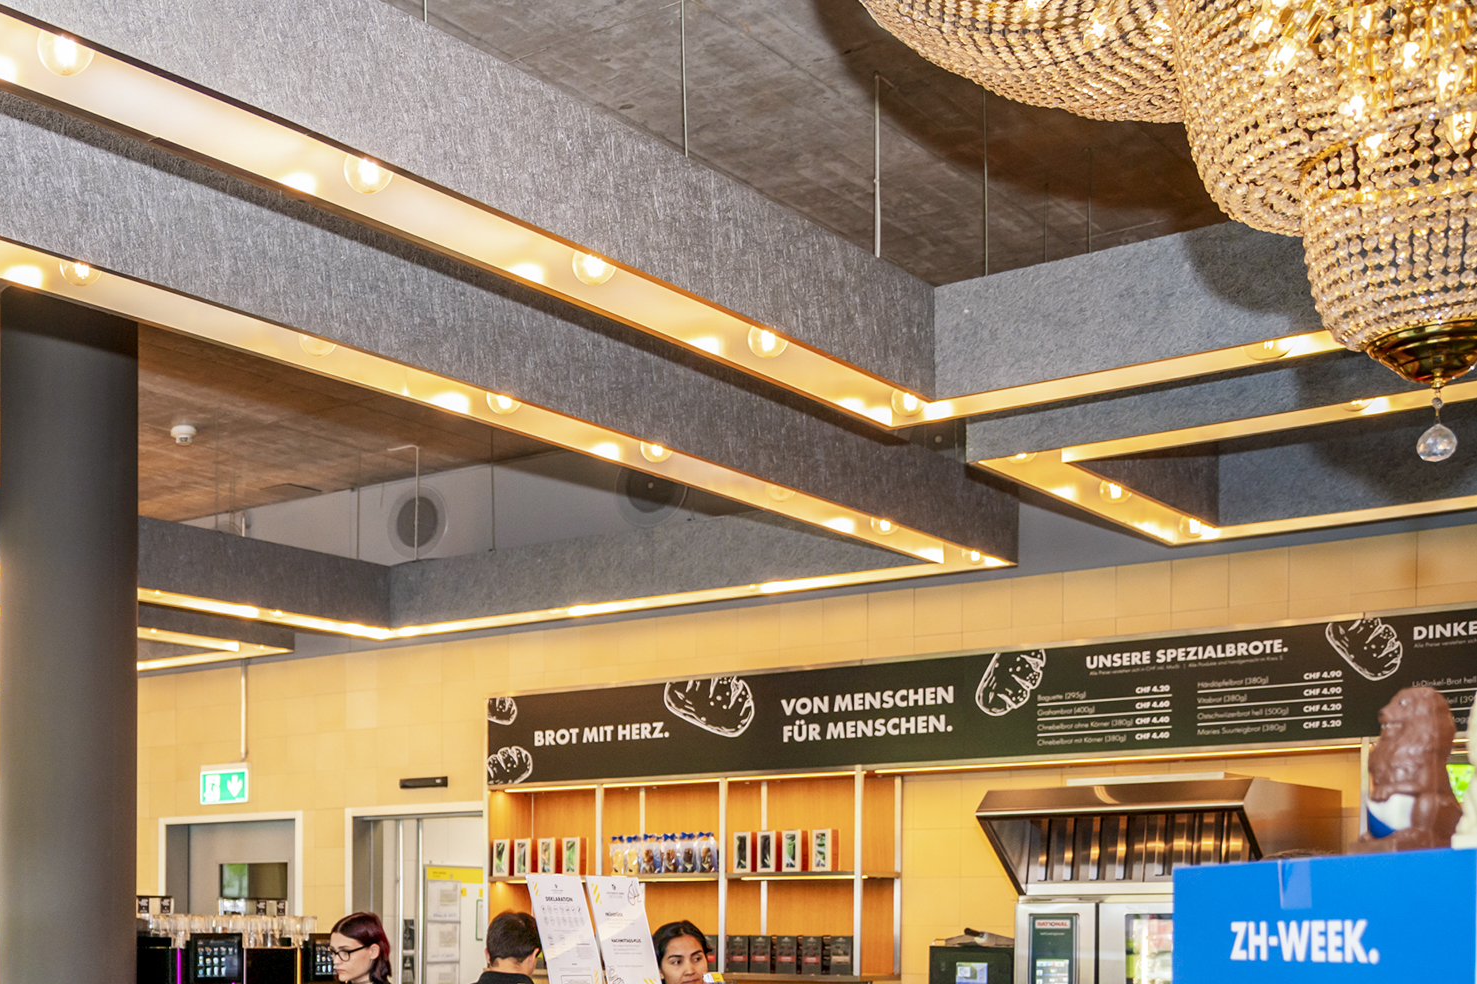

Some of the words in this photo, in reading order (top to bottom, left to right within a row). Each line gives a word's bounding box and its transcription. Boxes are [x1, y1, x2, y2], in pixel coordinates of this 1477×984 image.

[1086, 651, 1151, 669] UNSERE
[1156, 639, 1289, 664] SPEZIALBROTE.
[1303, 671, 1321, 681] CHF
[1322, 670, 1342, 679] 4.90
[1037, 693, 1064, 702] Baguette
[1135, 685, 1150, 694] CHF
[1151, 684, 1171, 693] 4.20
[1303, 687, 1321, 697] CHF
[1322, 686, 1342, 695] 4.90
[781, 695, 830, 716] VON
[834, 685, 954, 712] MENSCHEN
[1135, 701, 1150, 710] CHF
[1151, 700, 1171, 709] 4.60
[1303, 704, 1321, 713] CHF
[1322, 703, 1342, 712] 4.20
[1135, 716, 1150, 725] CHF
[1151, 715, 1171, 724] 4.40
[1303, 720, 1321, 729] CHF
[1322, 719, 1342, 728] 5.20
[782, 719, 822, 743] FÜR
[826, 714, 953, 740] MENSCHEN.
[534, 728, 579, 747] BROT
[582, 725, 614, 743] MIT
[618, 722, 670, 741] HERZ.
[1135, 732, 1150, 741] CHF
[1151, 731, 1171, 740] 4.40
[1230, 919, 1380, 965] ZH-WEEK.
